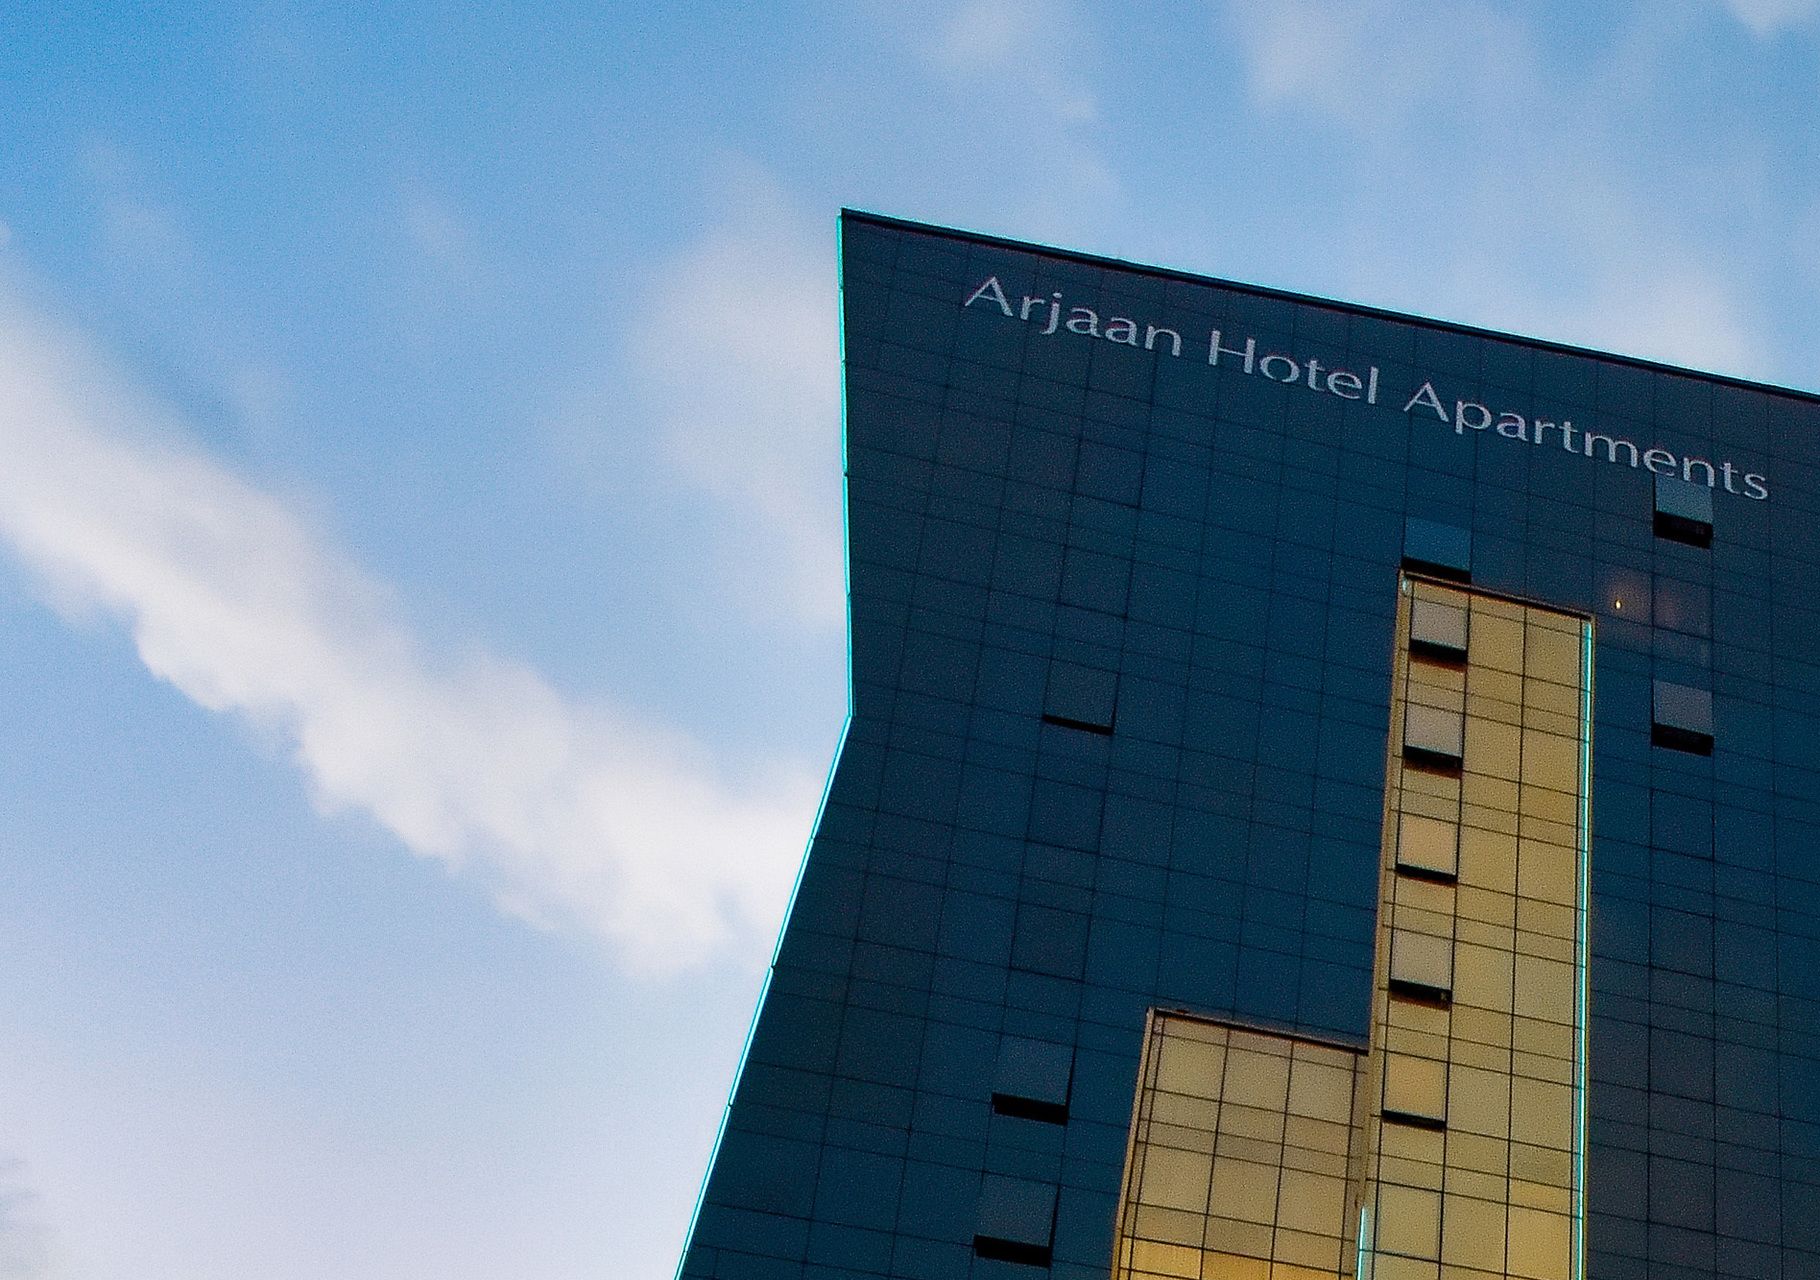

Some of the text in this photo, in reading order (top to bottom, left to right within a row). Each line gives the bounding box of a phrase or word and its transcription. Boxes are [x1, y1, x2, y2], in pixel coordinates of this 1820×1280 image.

[964, 275, 1769, 502] Arjaan Hotel Apartments
